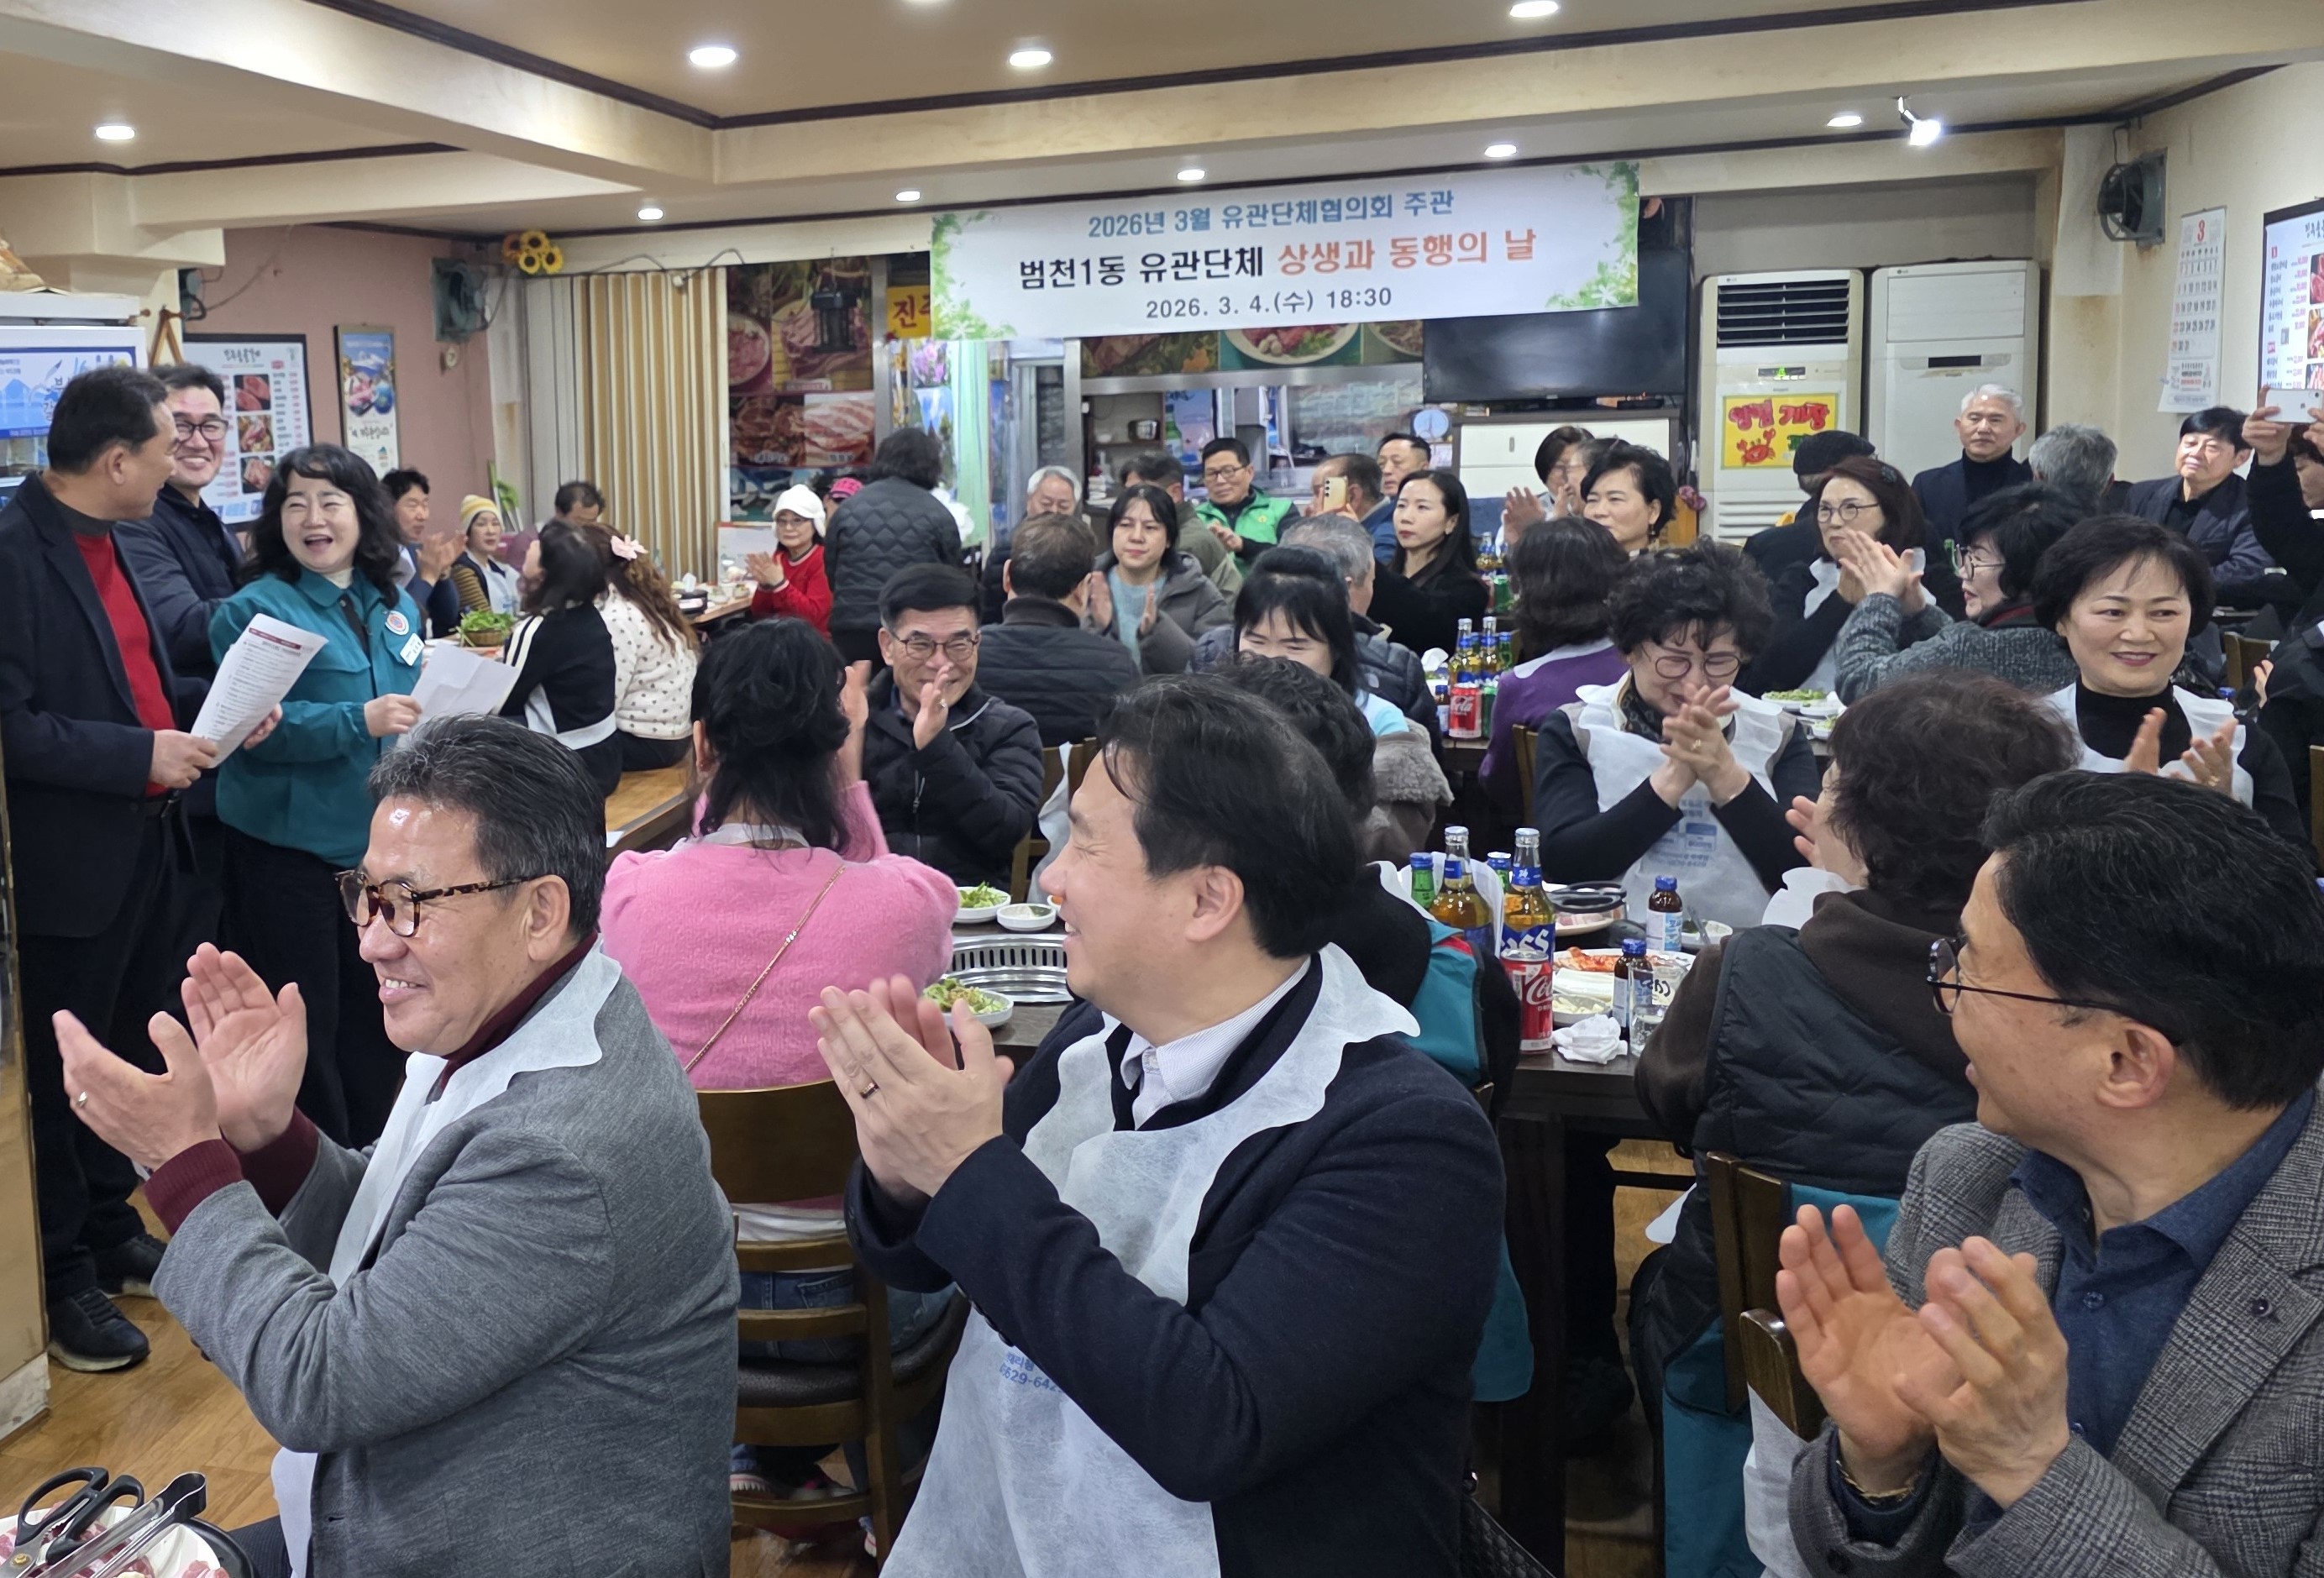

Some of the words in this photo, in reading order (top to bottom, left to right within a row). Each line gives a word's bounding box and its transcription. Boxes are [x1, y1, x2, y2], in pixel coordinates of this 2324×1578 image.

[1089, 211, 1164, 237] 2026년
[1174, 207, 1211, 231] 3월
[1222, 194, 1393, 229] 유관단체협의회
[1404, 190, 1454, 217] 주관
[2197, 219, 2206, 242] 3
[1020, 255, 1125, 290] 범천1동
[1139, 247, 1263, 284] 유관단체
[1277, 239, 1376, 275] 상생과
[1389, 231, 1487, 269] 동행의
[1505, 228, 1536, 260] 날
[1146, 298, 1209, 318] 2026.
[1219, 296, 1239, 316] 3.
[1250, 290, 1314, 314] 4.(수)
[1326, 286, 1392, 309] 18:30
[1779, 401, 1830, 431] 게장
